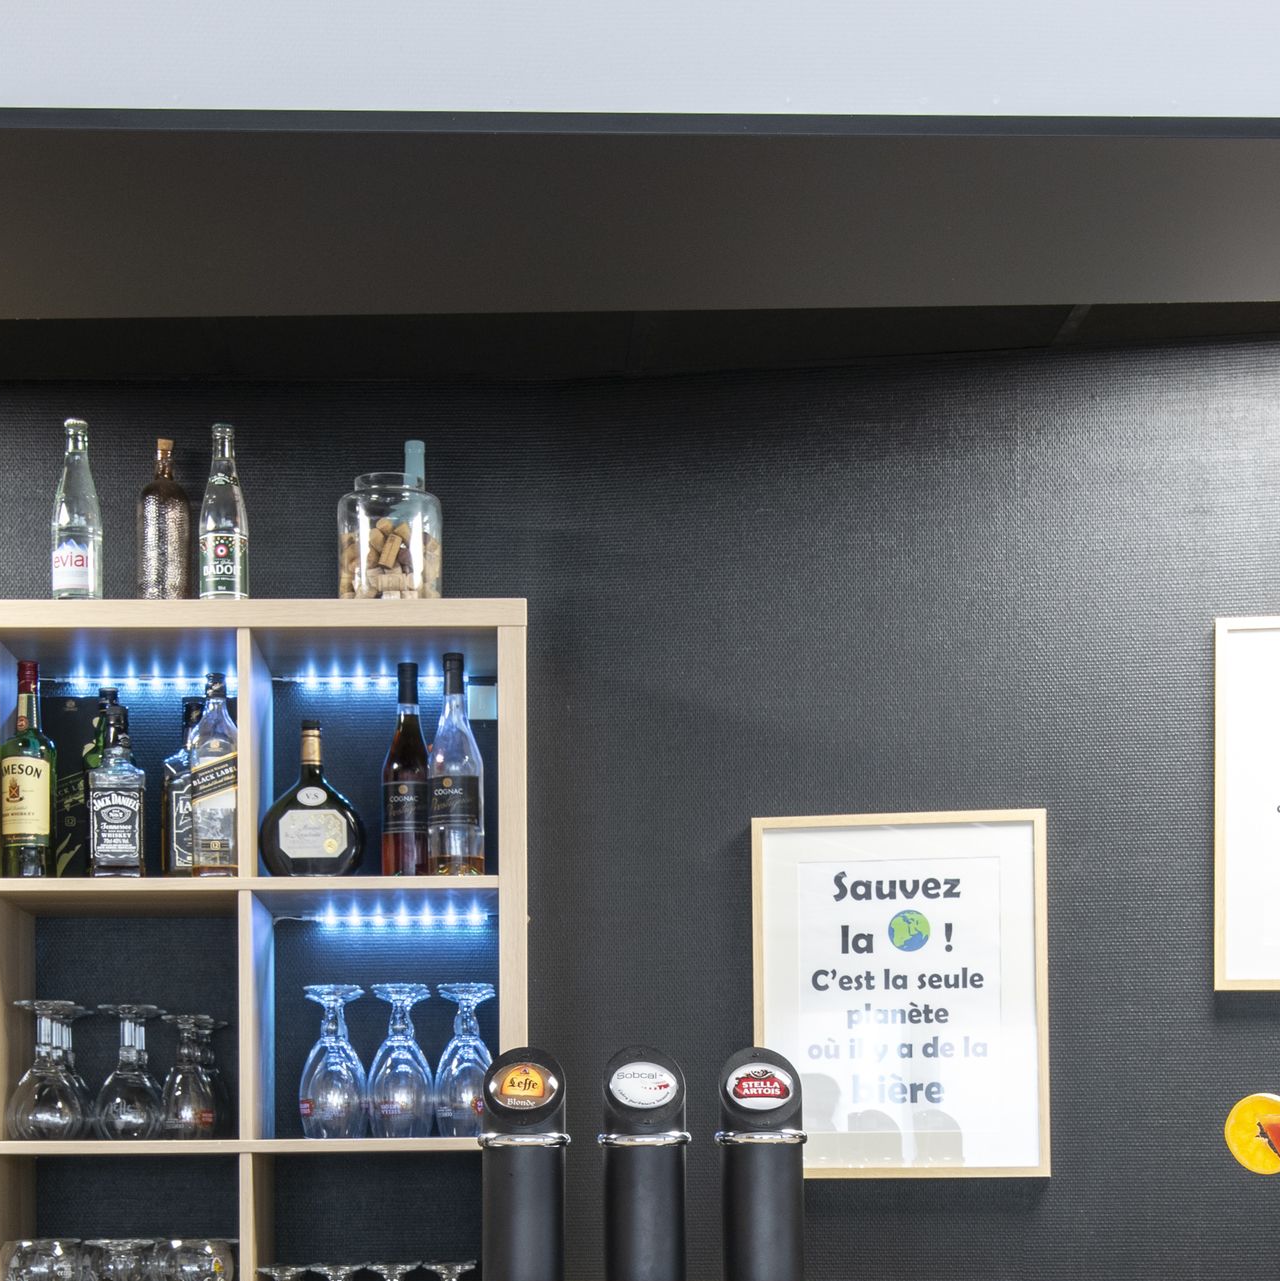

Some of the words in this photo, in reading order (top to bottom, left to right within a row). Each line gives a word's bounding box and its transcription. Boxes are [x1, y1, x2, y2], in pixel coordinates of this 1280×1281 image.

[192, 773, 216, 787] BLACK
[433, 787, 464, 796] COGNAC
[93, 797, 112, 812] JACK
[389, 795, 420, 803] COGNAC
[832, 870, 962, 903] Sauvez
[840, 924, 875, 955] la
[883, 968, 909, 991] la
[917, 966, 985, 990] seule
[807, 1036, 841, 1060] où
[896, 1042, 914, 1059] a
[921, 1035, 955, 1059] de
[963, 1035, 988, 1058] la
[506, 1076, 539, 1092] Leffe
[741, 1080, 781, 1089] STELLA
[742, 1087, 782, 1096] ARTOIS
[507, 1097, 537, 1107] Blonde
